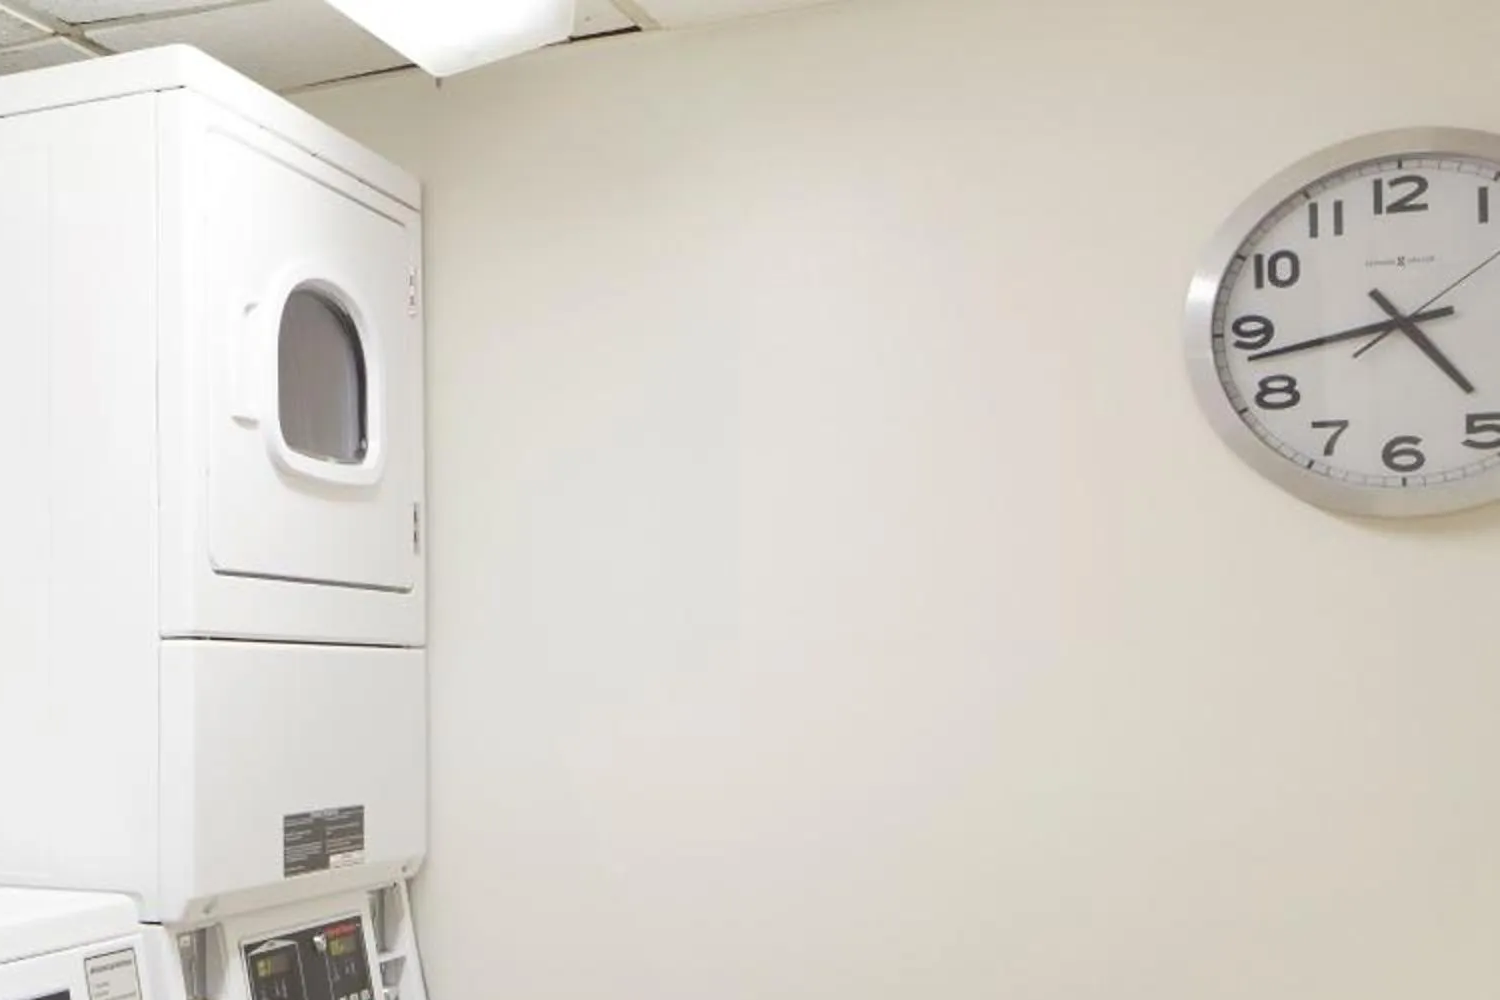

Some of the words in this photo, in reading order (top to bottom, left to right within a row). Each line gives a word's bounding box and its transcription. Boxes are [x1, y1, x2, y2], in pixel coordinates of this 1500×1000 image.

[1372, 174, 1429, 214] 12
[1477, 186, 1489, 224] 1
[1308, 200, 1343, 239] 11
[1253, 249, 1300, 290] 10
[1231, 314, 1275, 351] 9
[1254, 374, 1301, 411] 8
[1311, 419, 1349, 457] 7
[1460, 411, 1500, 450] 5
[1381, 435, 1426, 473] 6
